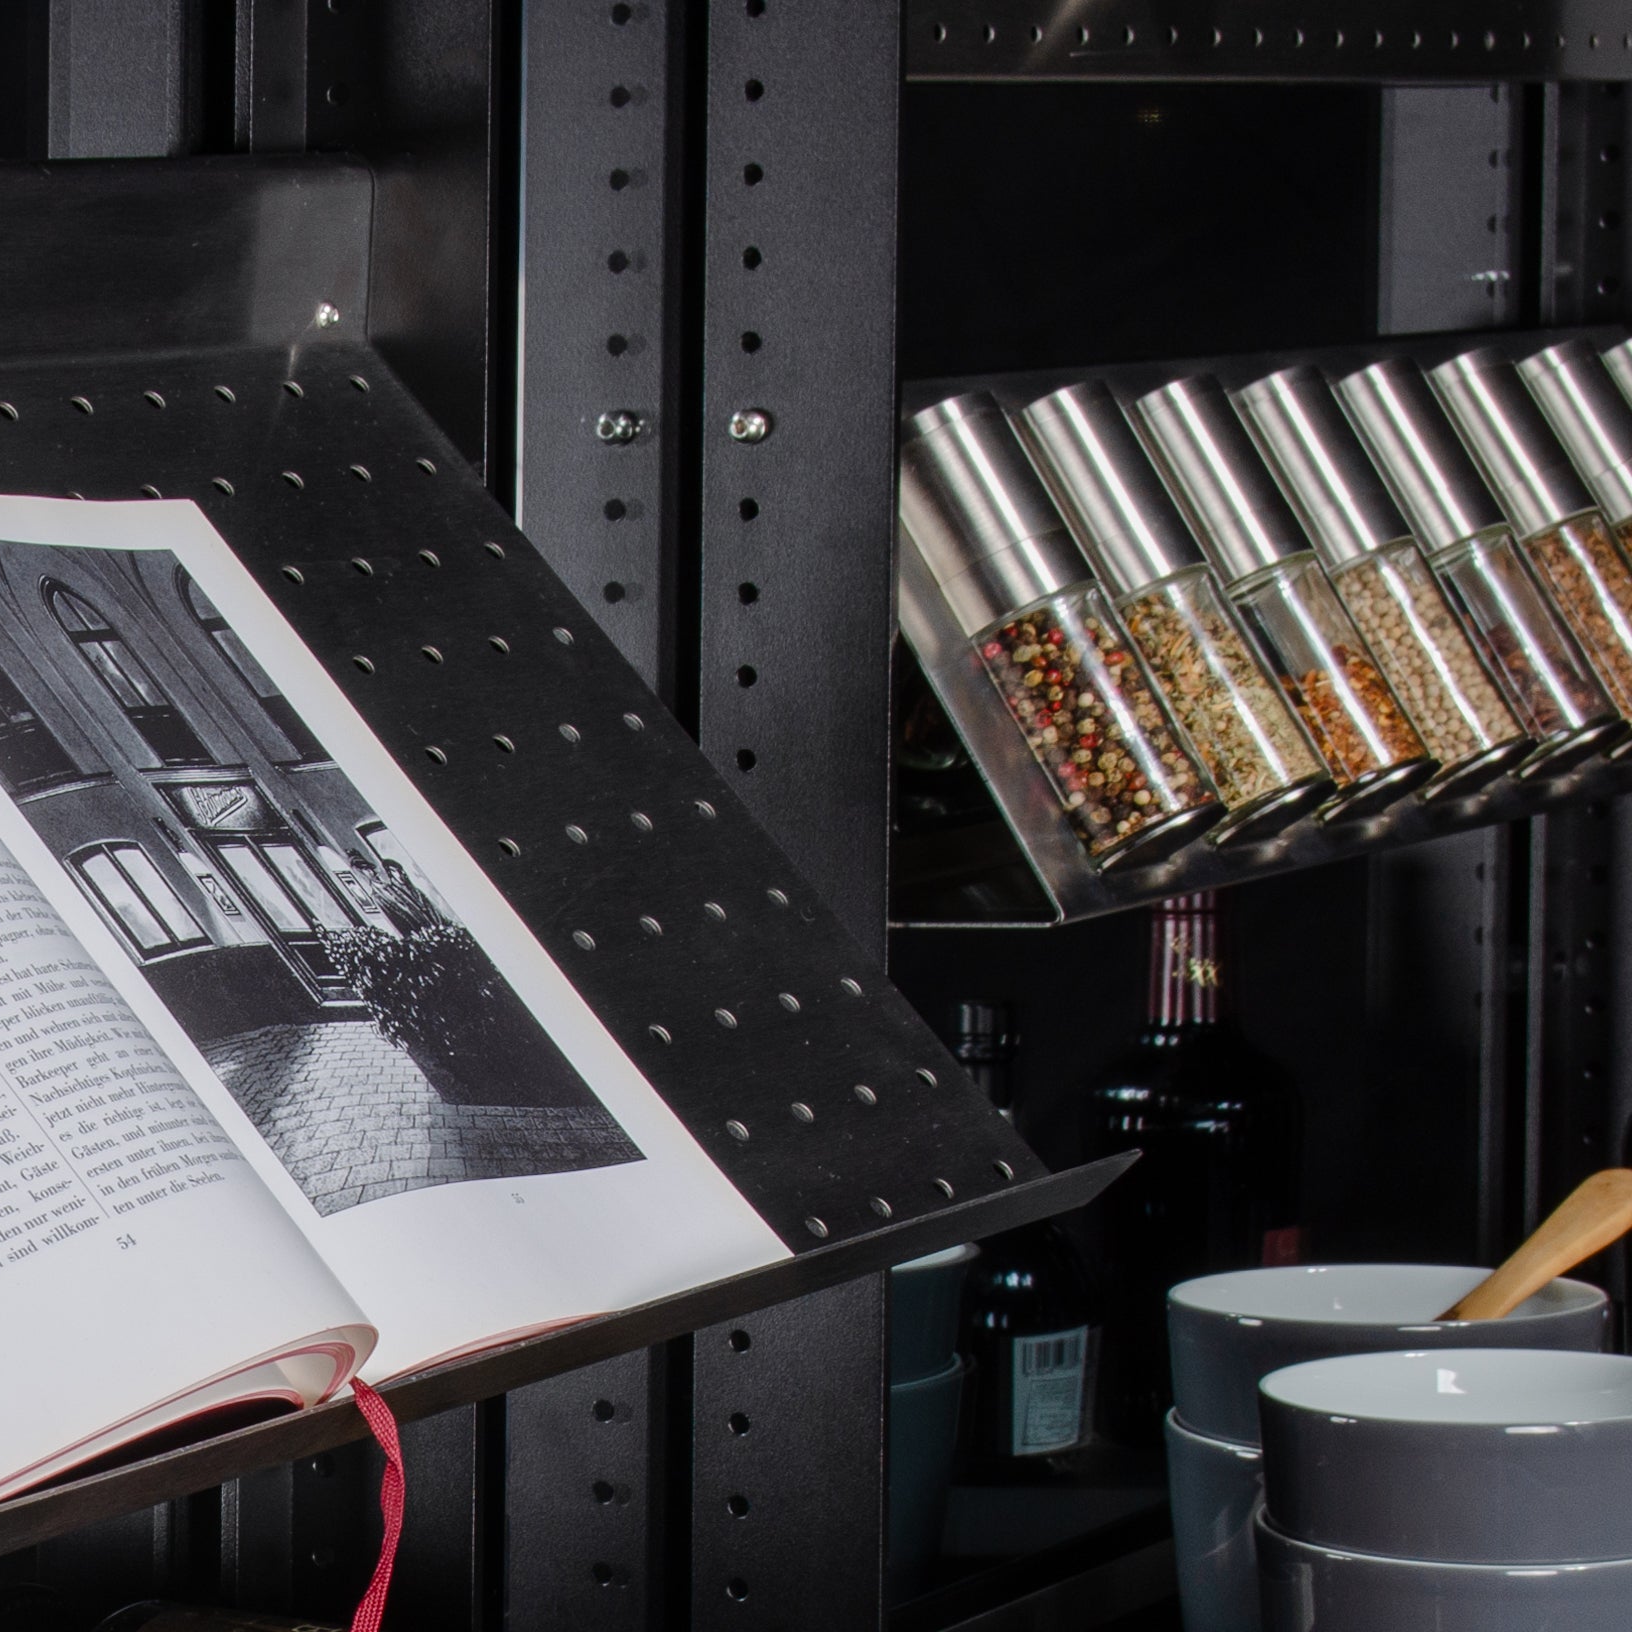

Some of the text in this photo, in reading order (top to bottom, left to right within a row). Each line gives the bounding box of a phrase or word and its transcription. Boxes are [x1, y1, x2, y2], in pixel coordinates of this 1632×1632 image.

[19, 1001, 66, 1020] blicken
[13, 1061, 79, 1089] Barkeeper
[71, 1138, 121, 1160] Gästen,
[121, 1124, 147, 1142] und
[27, 1180, 72, 1202] konse-
[96, 1184, 116, 1197] in
[116, 1175, 141, 1190] den
[7, 1239, 38, 1262] sind
[41, 1216, 99, 1245] willkom-
[115, 1233, 138, 1252] 54
